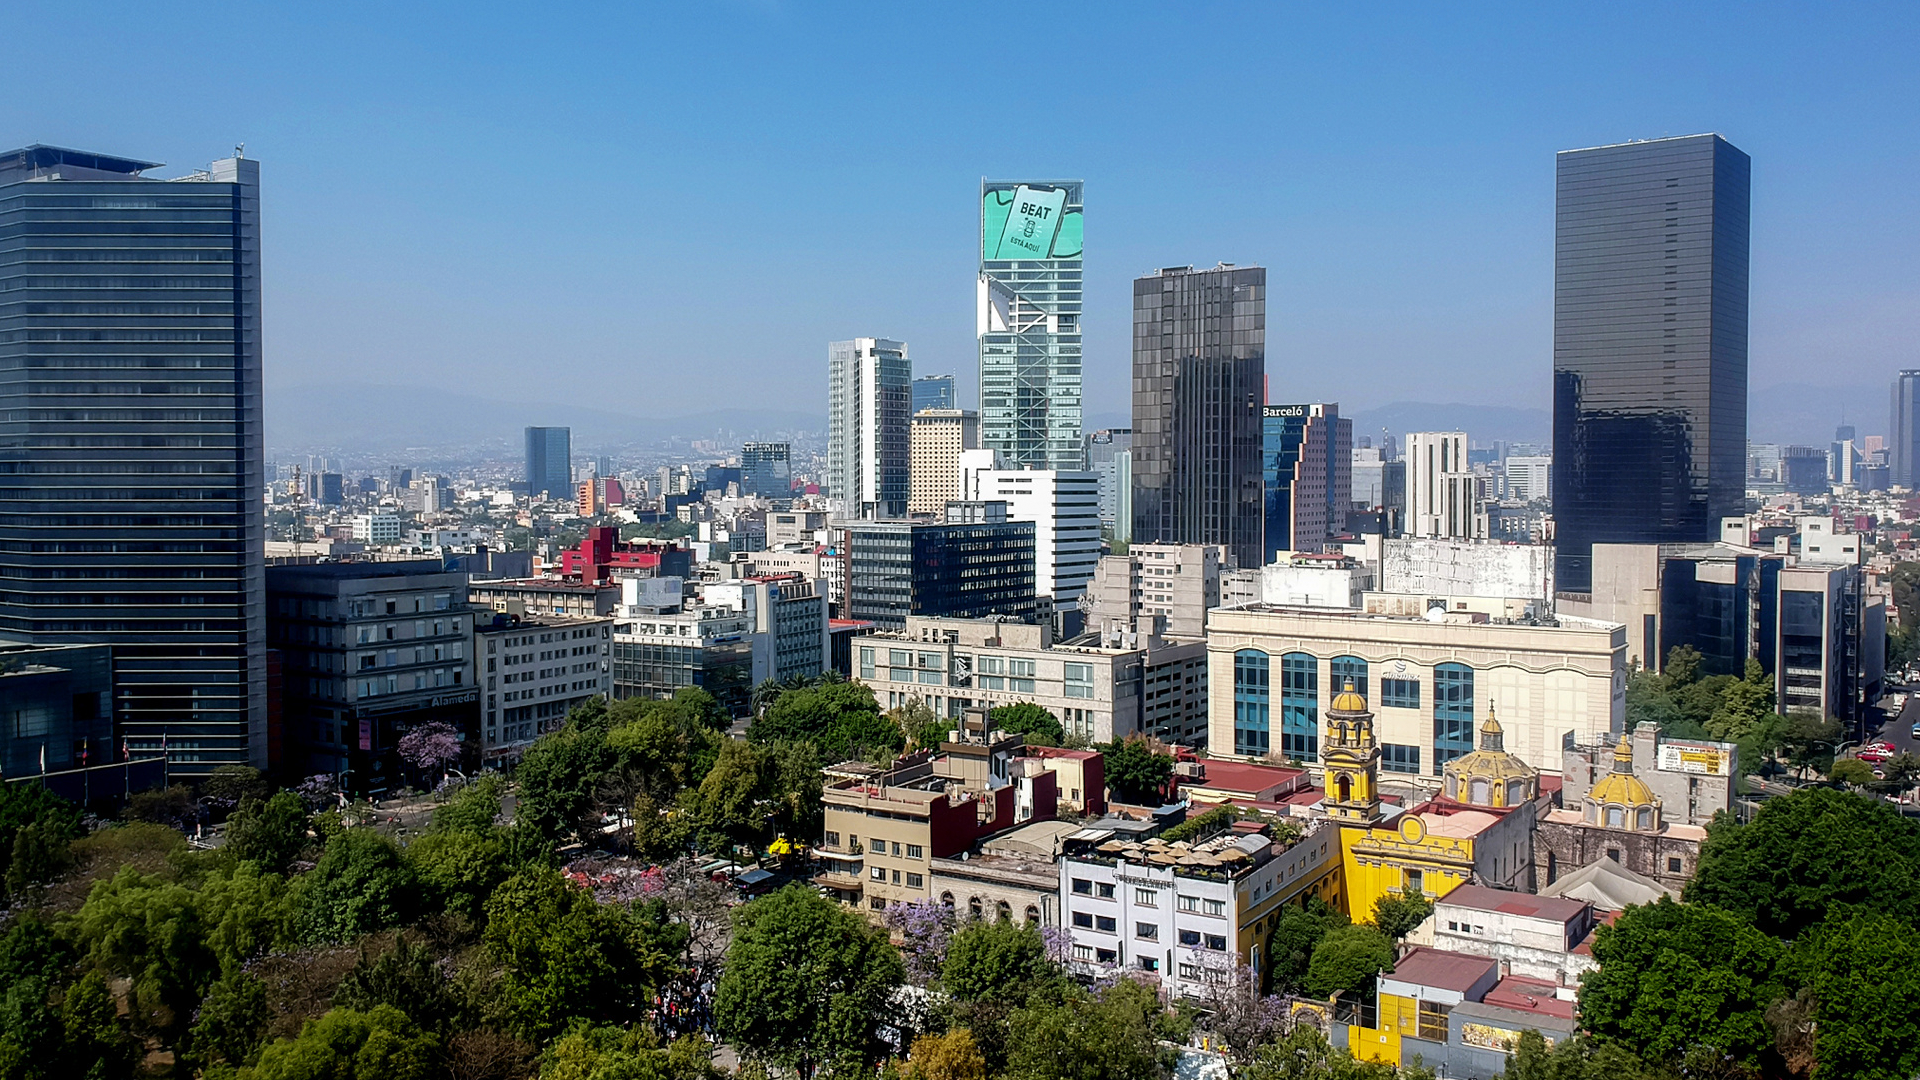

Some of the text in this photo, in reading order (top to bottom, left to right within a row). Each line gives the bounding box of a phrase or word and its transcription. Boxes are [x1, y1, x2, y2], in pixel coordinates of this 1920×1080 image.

[1020, 202, 1051, 220] BEAT
[1024, 243, 1040, 253] AQUÍ
[1262, 406, 1303, 417] Barceló
[901, 685, 973, 697] SCIENTOLOGY
[431, 692, 476, 707] Alameda
